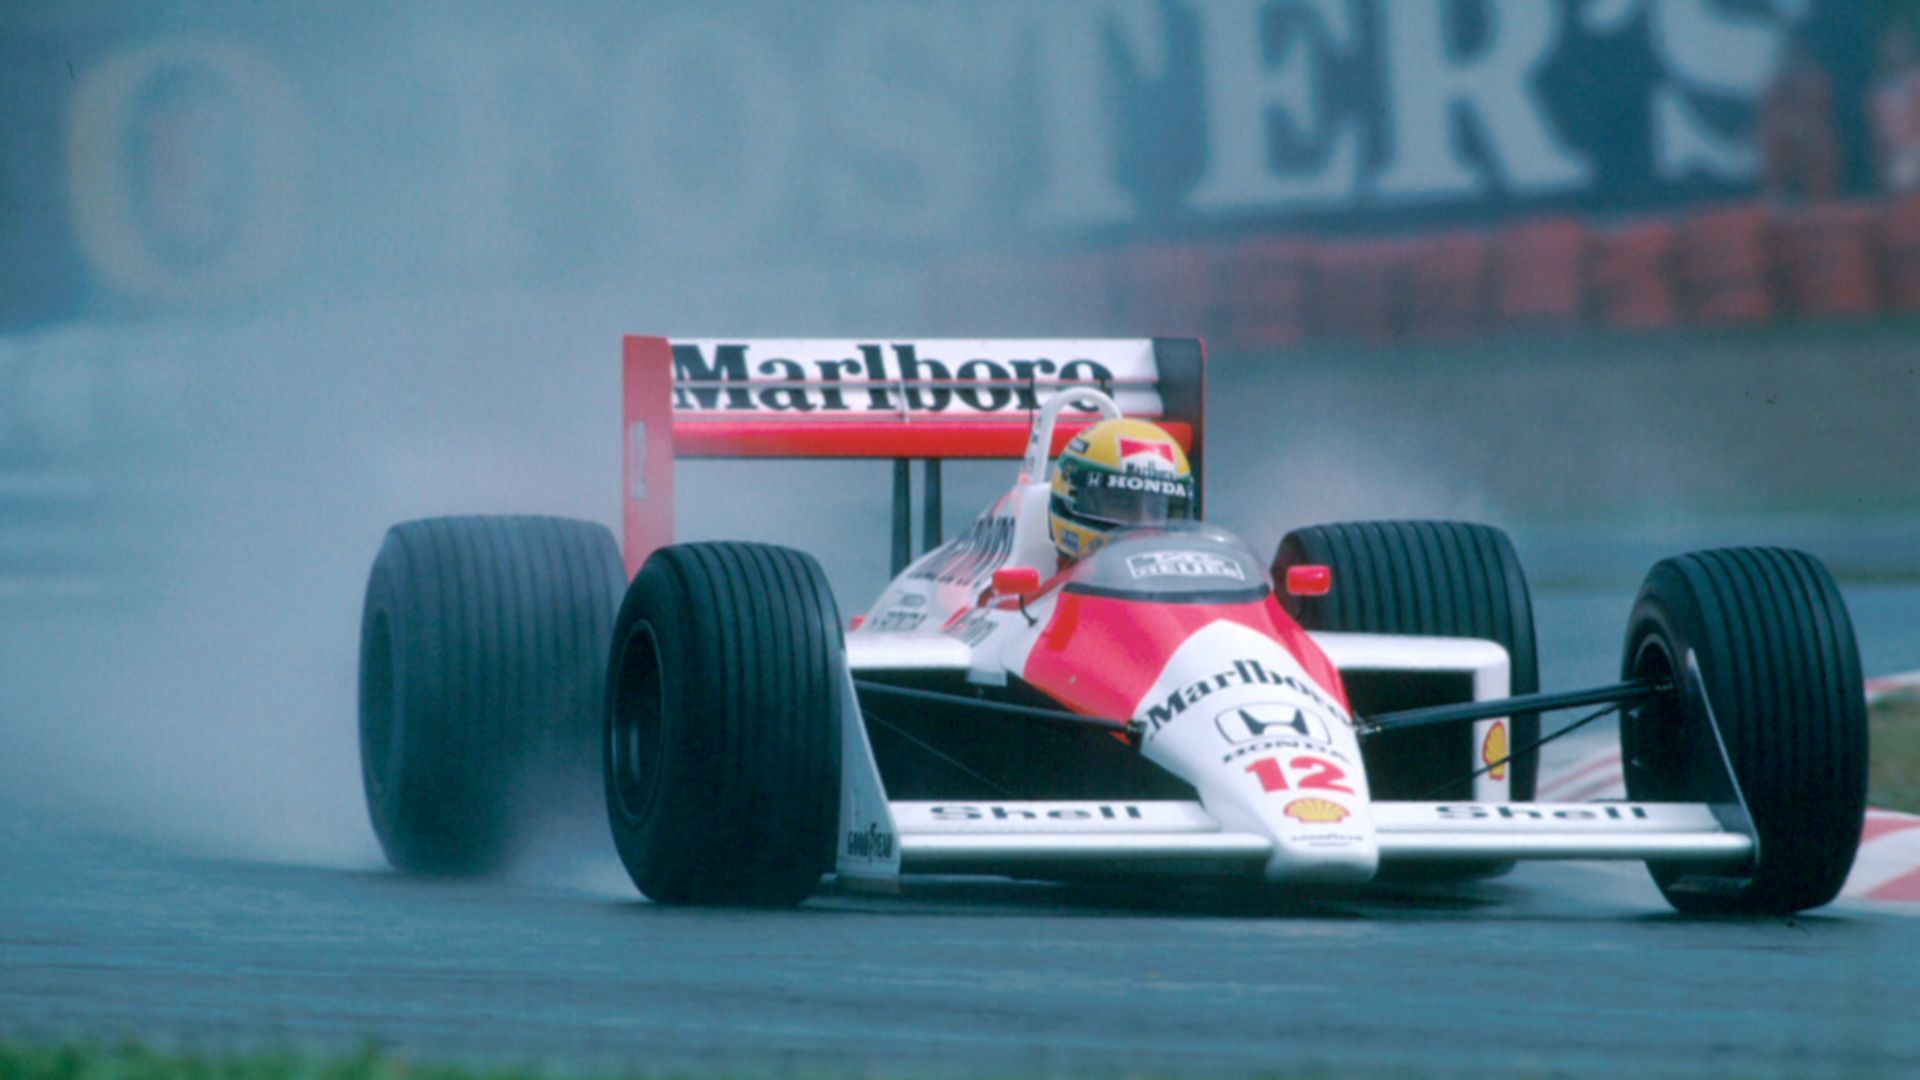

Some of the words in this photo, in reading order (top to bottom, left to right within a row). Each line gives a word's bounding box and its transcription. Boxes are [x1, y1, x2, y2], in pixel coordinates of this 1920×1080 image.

[671, 344, 1113, 412] Marlboro
[1107, 475, 1186, 497] HONDA
[1147, 659, 1353, 741] Marlboro
[1222, 739, 1351, 765] HONDA
[1245, 756, 1355, 795] 12
[930, 805, 1142, 819] Shell
[1437, 805, 1648, 819] Shell
